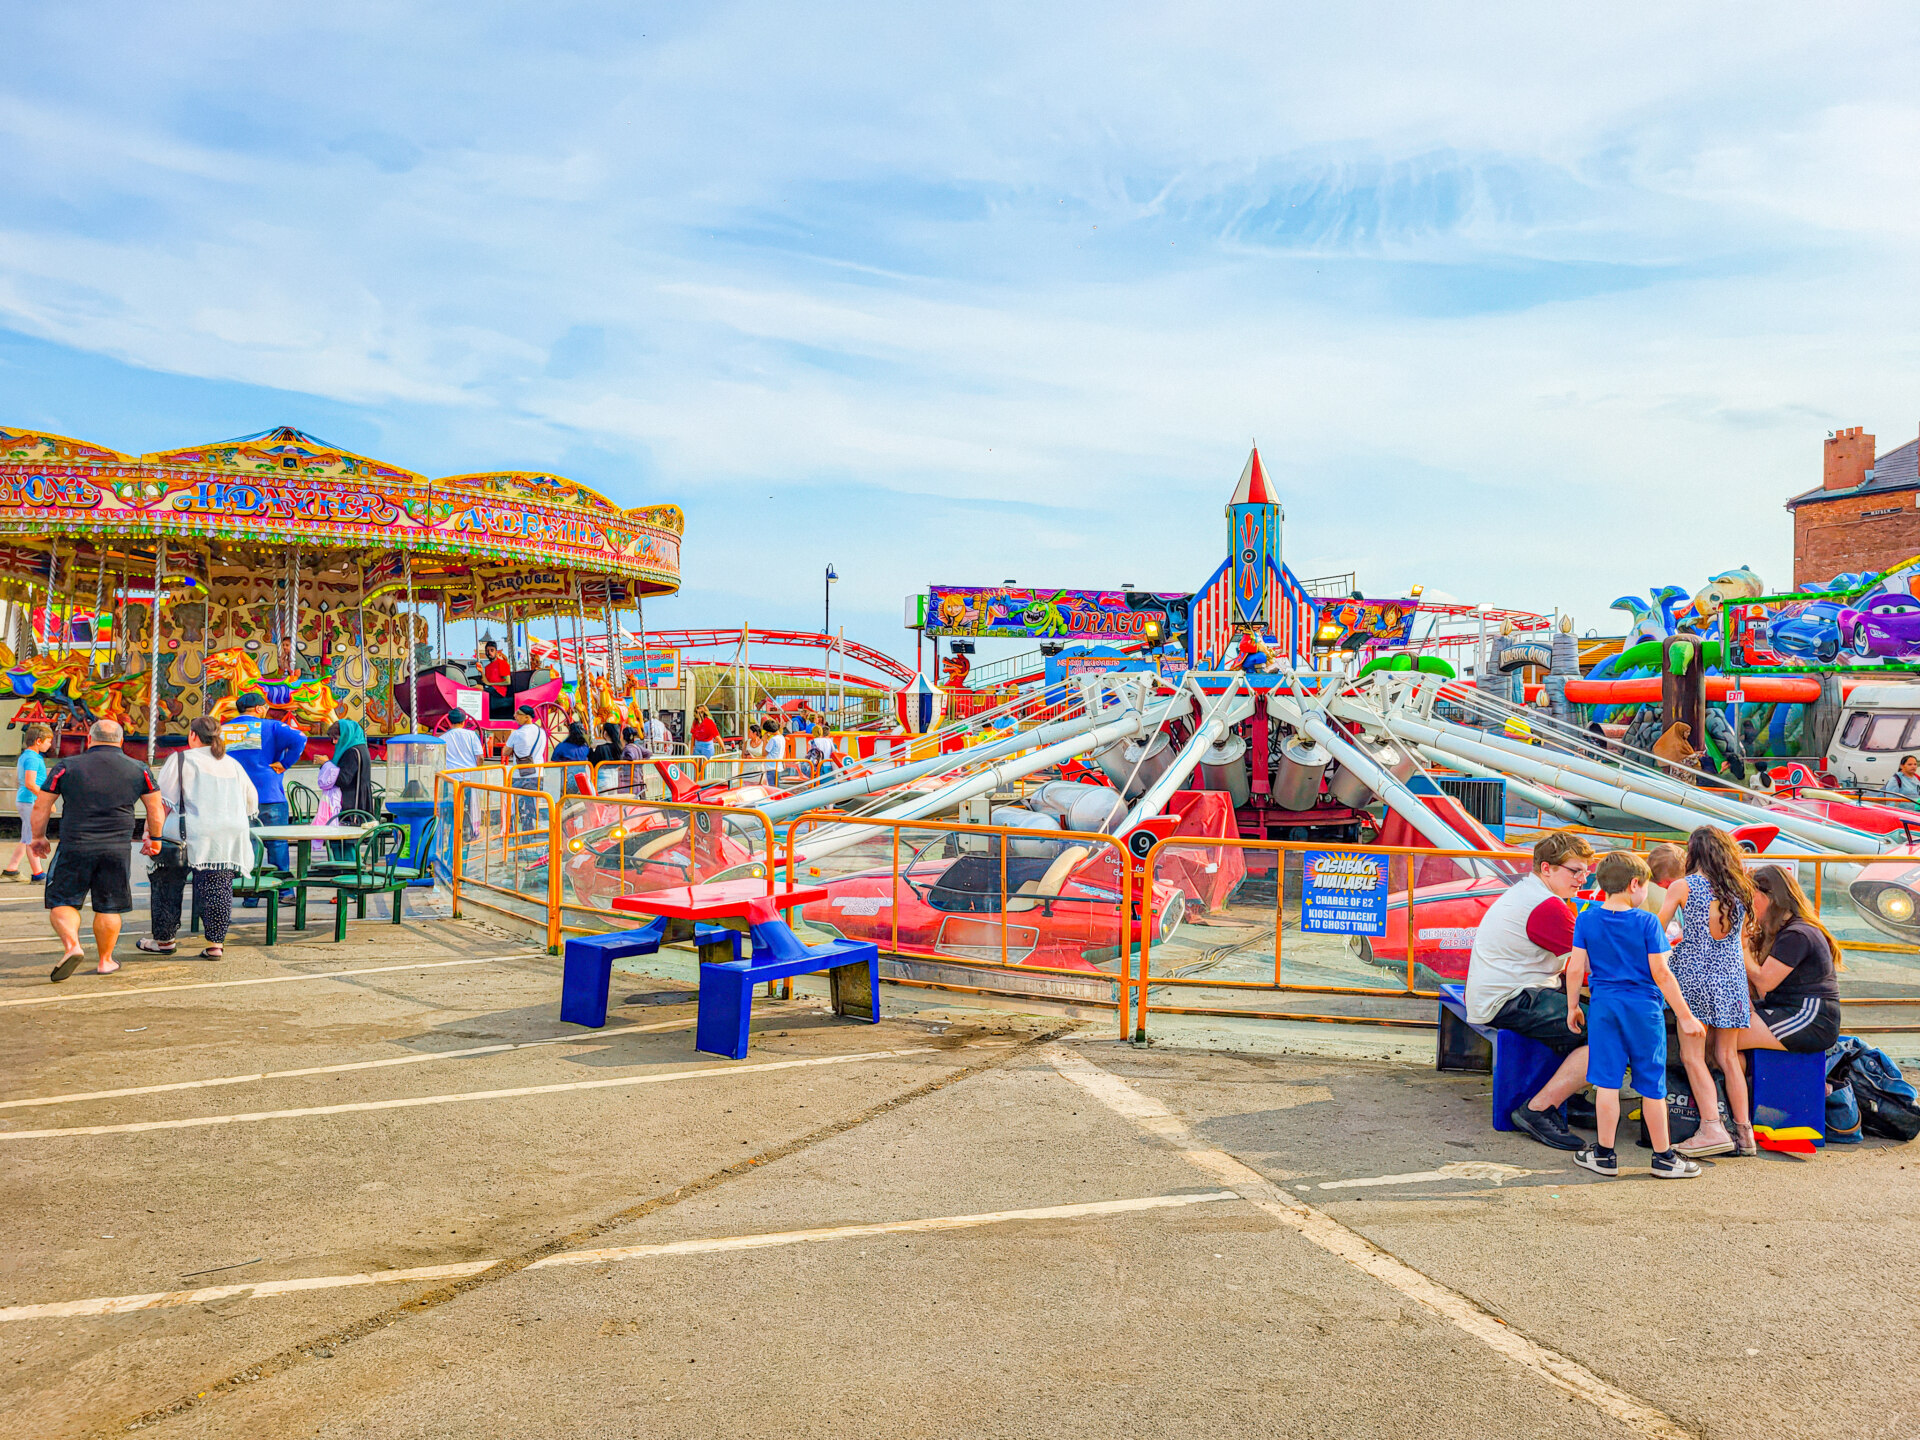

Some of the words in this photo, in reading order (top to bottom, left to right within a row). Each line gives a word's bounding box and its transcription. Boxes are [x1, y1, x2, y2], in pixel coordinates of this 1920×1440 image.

[488, 574, 560, 591] CAROUSEL
[1728, 692, 1742, 701] EXIT
[1138, 836, 1150, 853] 9
[1314, 858, 1379, 875] CASHBACK
[1313, 874, 1378, 891] AVAILABLE
[1315, 895, 1349, 906] CHARGE
[1350, 897, 1361, 907] OF
[1362, 898, 1374, 908] £2
[1308, 909, 1335, 920] KIOSK
[1336, 911, 1378, 922] ADJACENT
[1309, 919, 1321, 929] TO
[1322, 920, 1351, 931] GHOST
[1352, 922, 1378, 932] TRAIN
